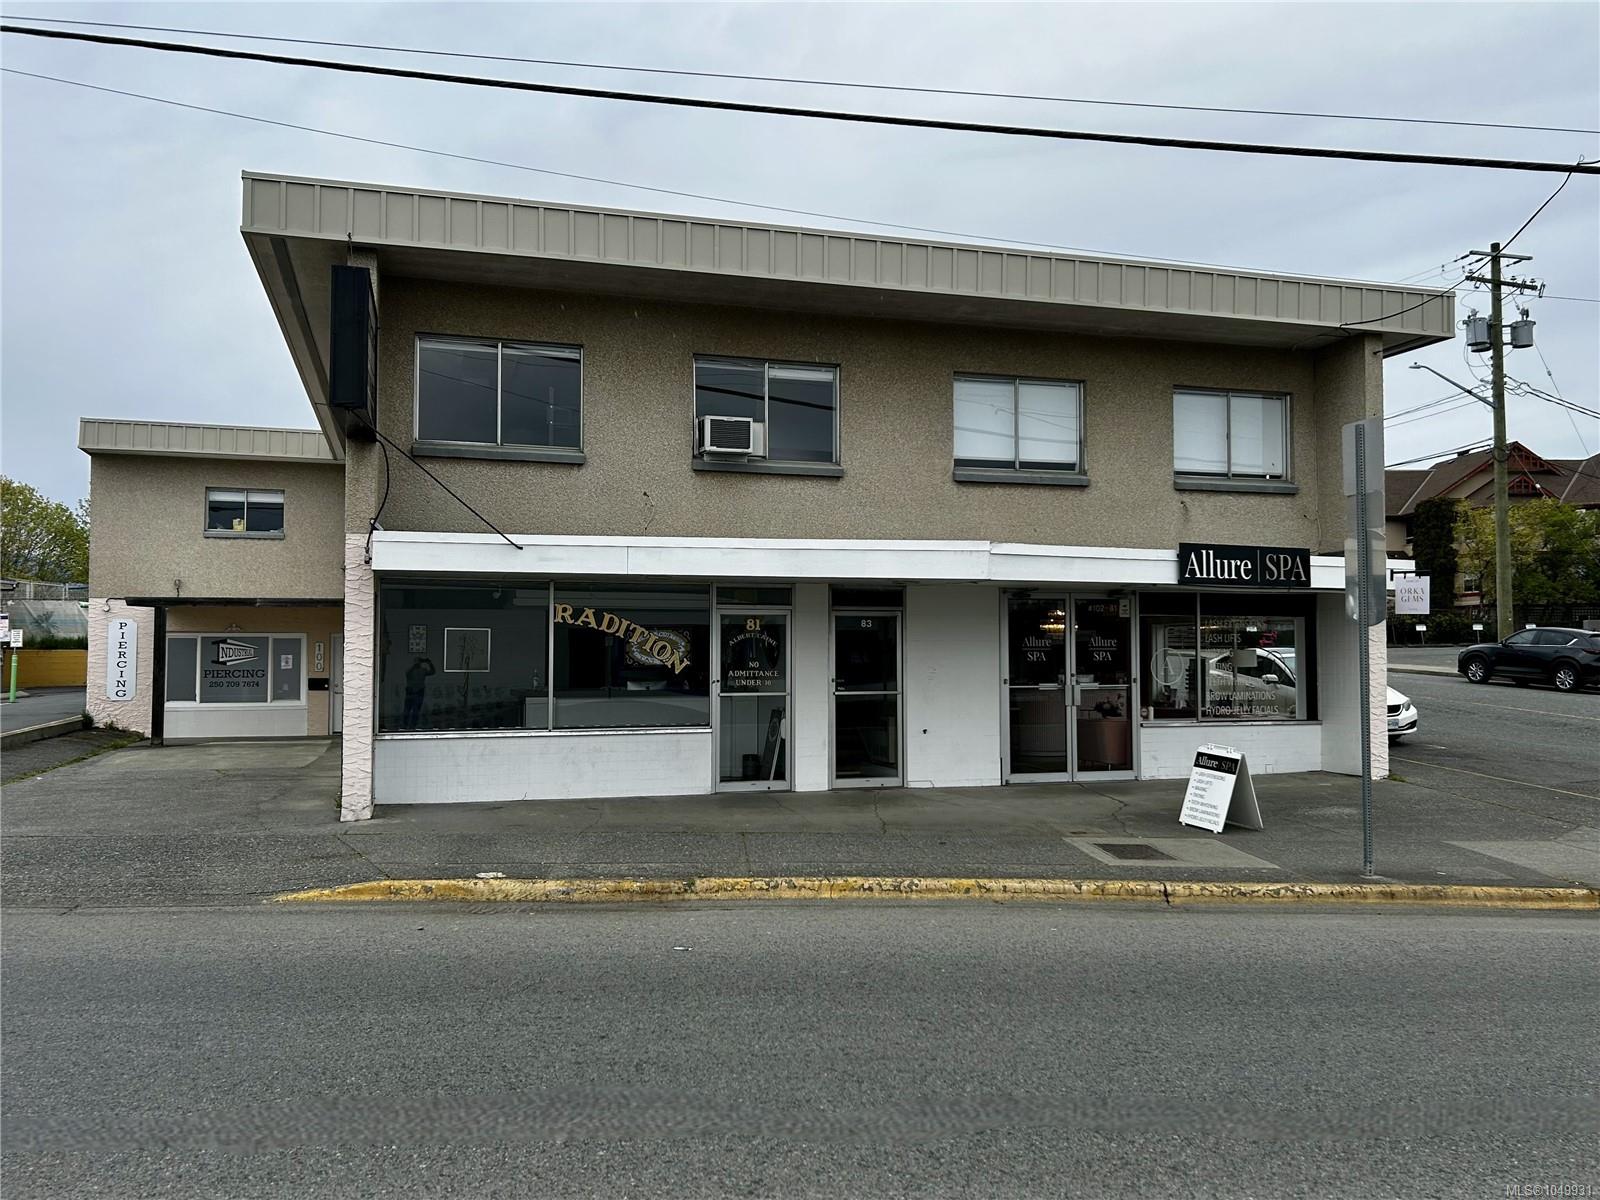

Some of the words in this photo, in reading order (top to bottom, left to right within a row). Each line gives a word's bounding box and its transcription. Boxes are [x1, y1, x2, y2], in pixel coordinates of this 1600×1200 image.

[1185, 550, 1252, 580] Allure
[1265, 553, 1307, 581] SPA
[1400, 587, 1425, 595] ORKA
[746, 618, 760, 631] 81
[861, 619, 872, 628] 83
[554, 603, 691, 675] RADITION
[1022, 636, 1052, 647] Allure
[1088, 636, 1118, 647] Allure
[1205, 633, 1223, 643] LASH
[115, 622, 128, 698] PIERCING
[1027, 652, 1047, 661] SPA
[1093, 652, 1112, 661] SPA
[203, 669, 265, 679] PIERCING
[1206, 691, 1230, 700] BROW
[1230, 691, 1276, 700] LAMINATIONS
[1252, 705, 1279, 714] FACIALS
[1196, 755, 1219, 768] Allure
[1221, 760, 1236, 772] SPA
